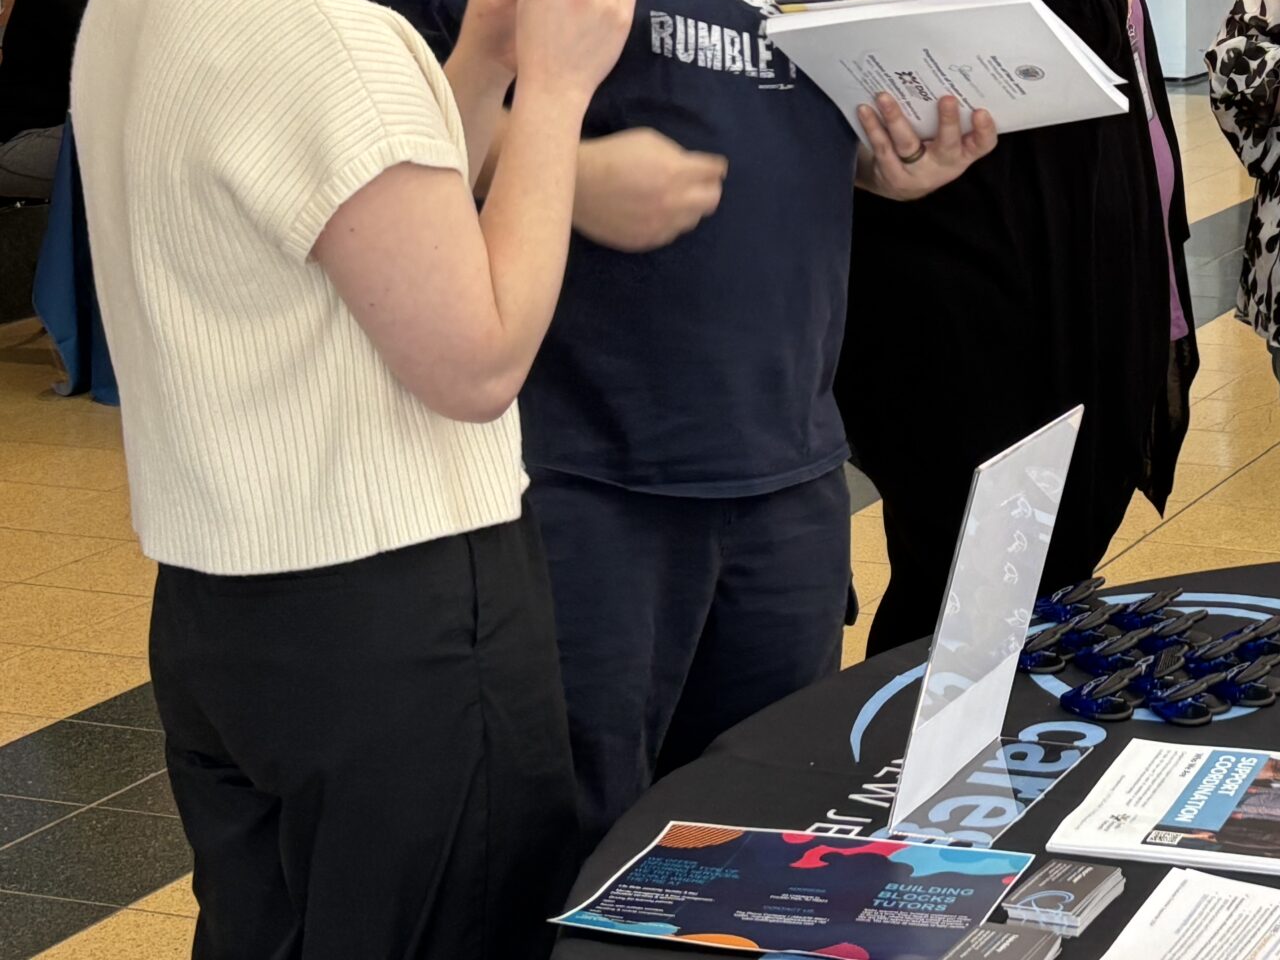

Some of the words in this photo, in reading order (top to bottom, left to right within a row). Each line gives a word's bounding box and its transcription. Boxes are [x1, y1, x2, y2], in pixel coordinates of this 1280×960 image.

[650, 10, 776, 79] RUMBLE
[1174, 755, 1236, 823] COORDINATION
[1217, 757, 1258, 797] SUPPORT
[877, 891, 957, 904] BLOCKS
[884, 883, 975, 897] BUILDING
[873, 898, 948, 912] TUTORS
